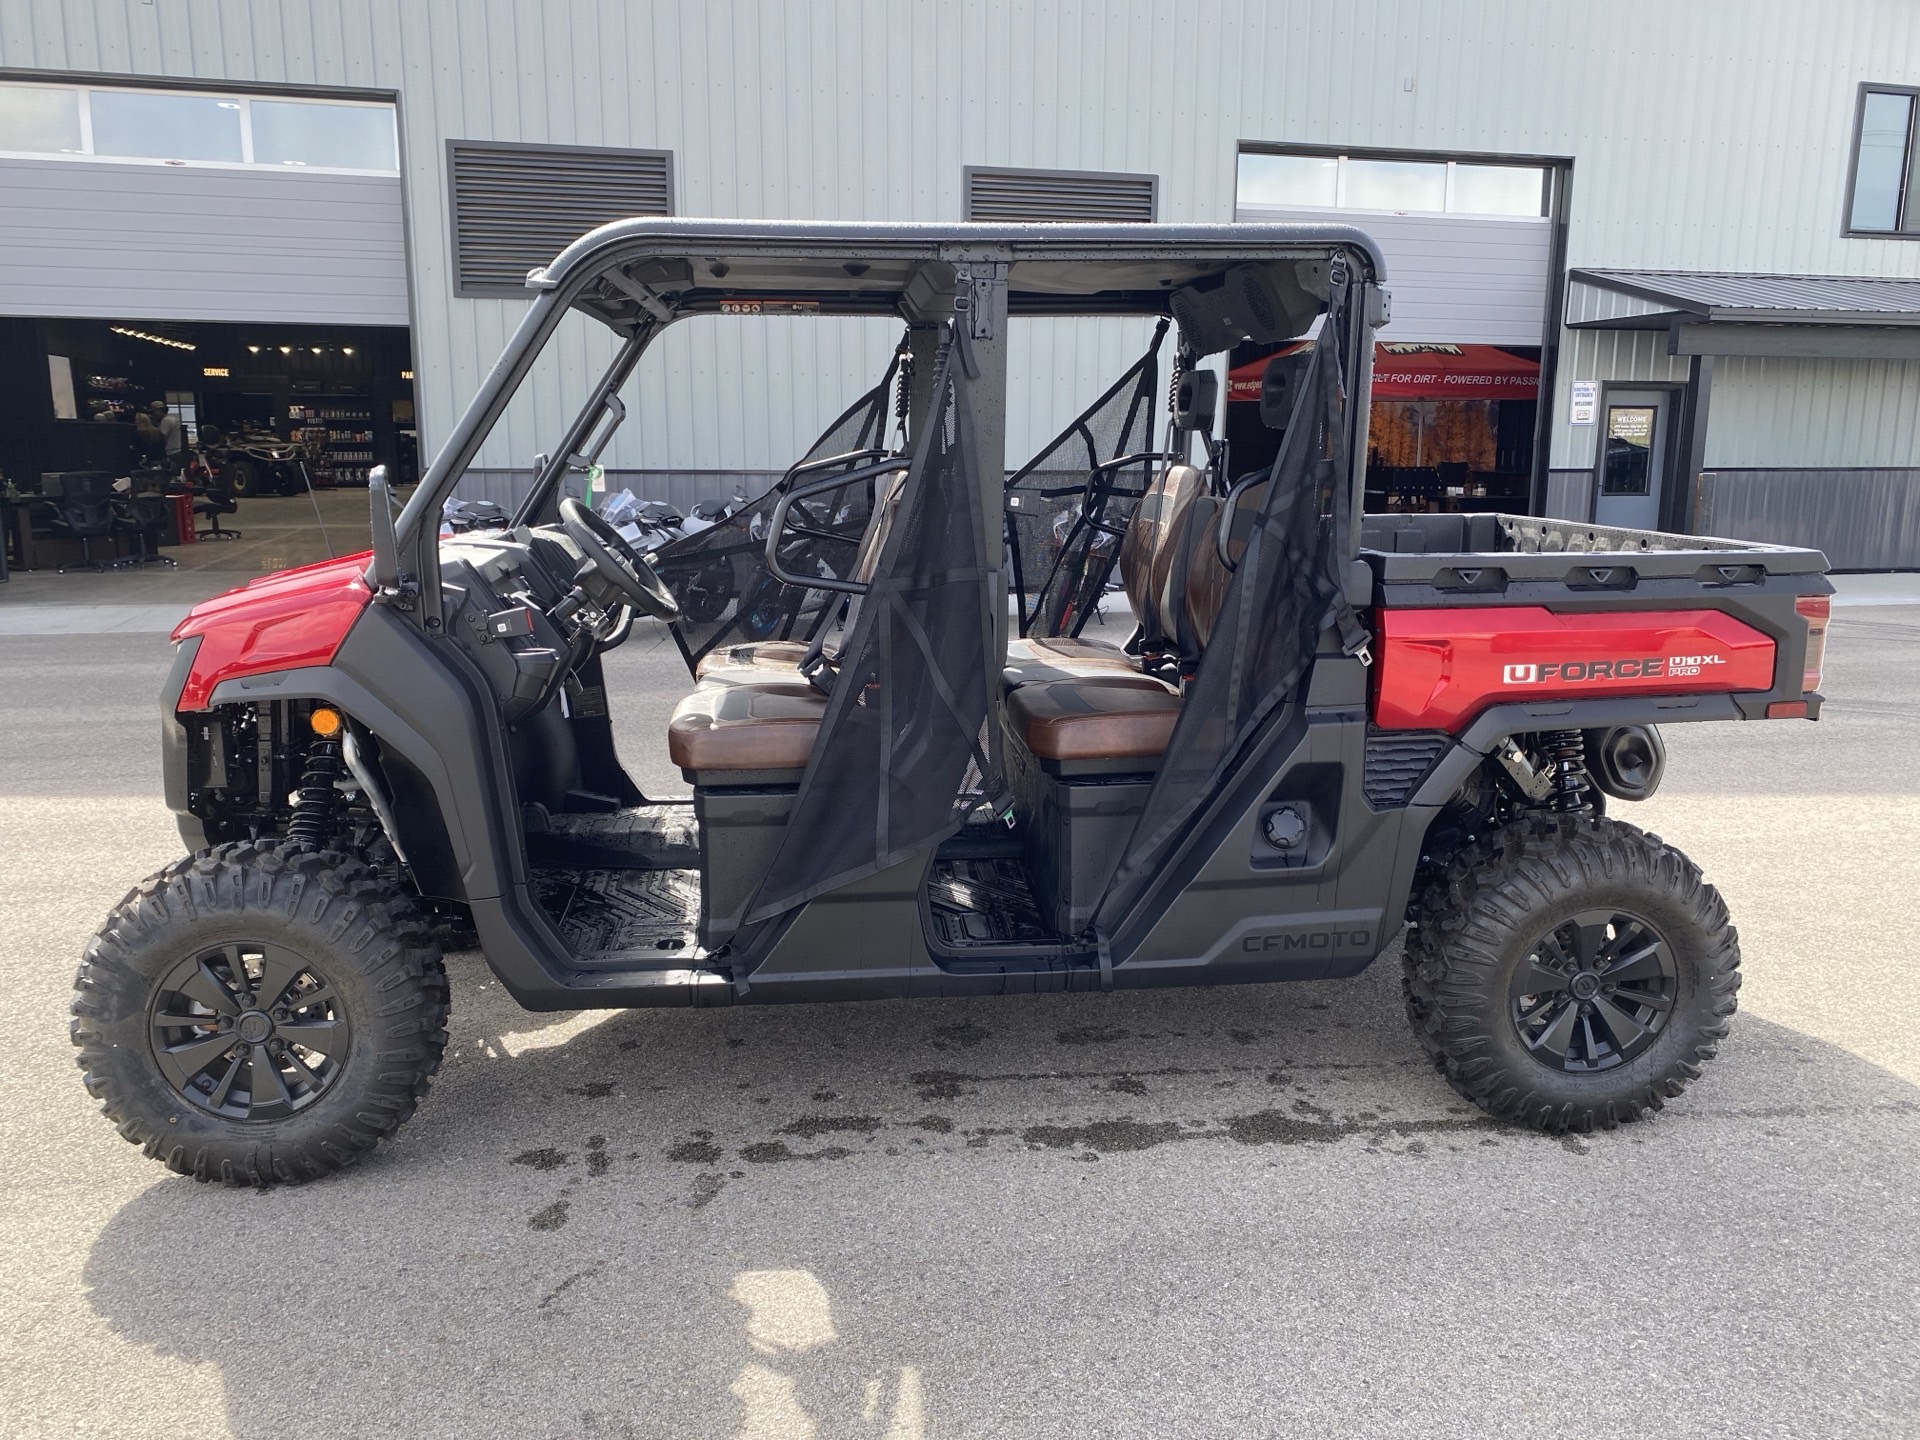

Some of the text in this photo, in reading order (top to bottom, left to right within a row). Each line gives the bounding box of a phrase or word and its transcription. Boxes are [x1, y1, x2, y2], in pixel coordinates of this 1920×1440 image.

[203, 368, 229, 377] SERVICE
[1391, 374, 1412, 384] FOR
[1413, 374, 1438, 384] DIRT
[1443, 375, 1493, 385] POWERED
[1494, 376, 1509, 385] BY
[1668, 667, 1701, 676] PRO
[1242, 930, 1371, 953] CFMOTO
